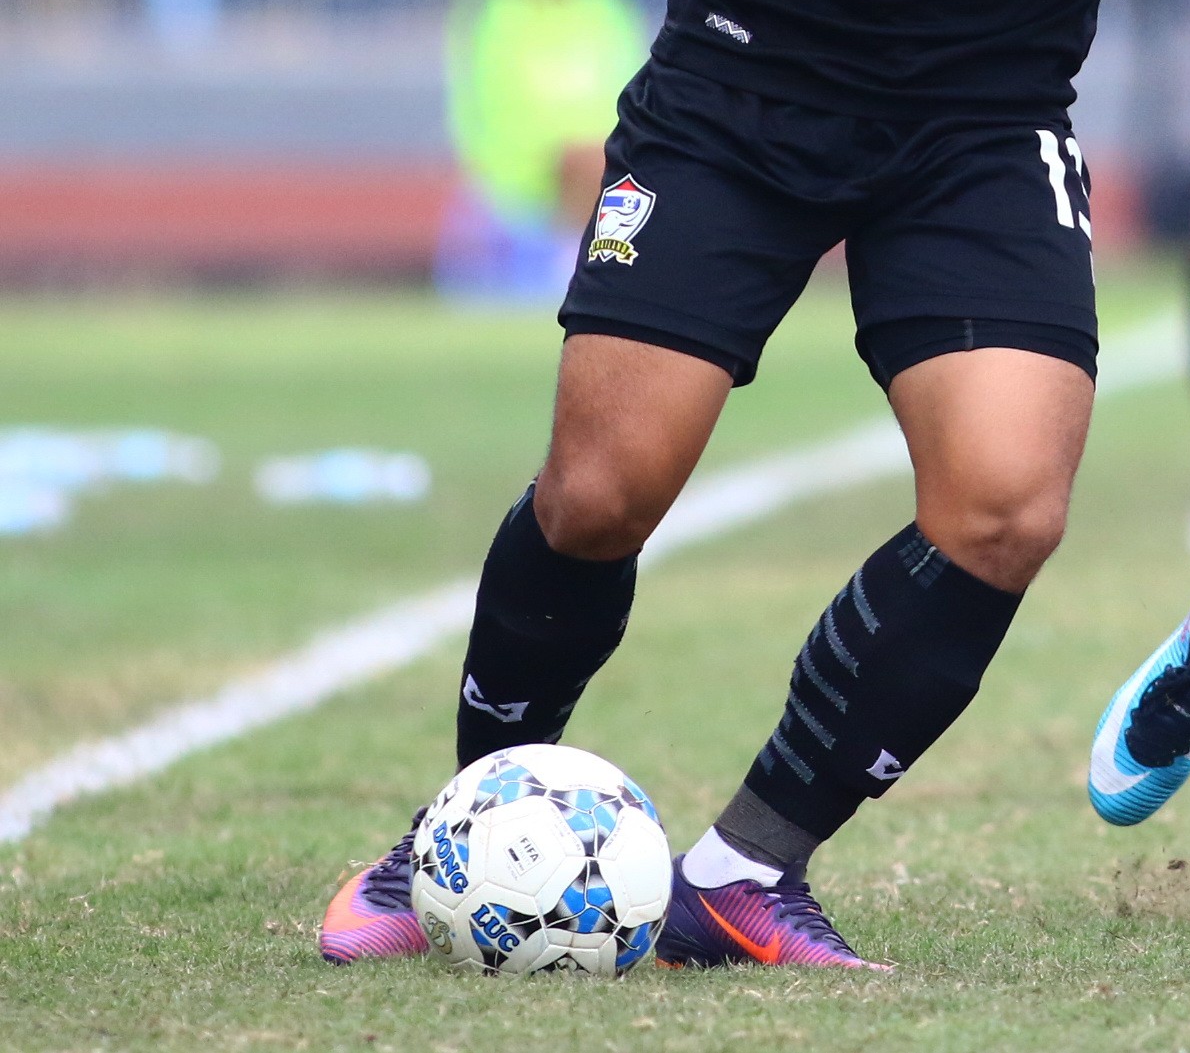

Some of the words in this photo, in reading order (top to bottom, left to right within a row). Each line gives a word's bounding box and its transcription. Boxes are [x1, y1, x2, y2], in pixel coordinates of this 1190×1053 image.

[432, 820, 470, 895] DONG
[520, 837, 539, 862] FIFA
[470, 903, 521, 953] LUC
